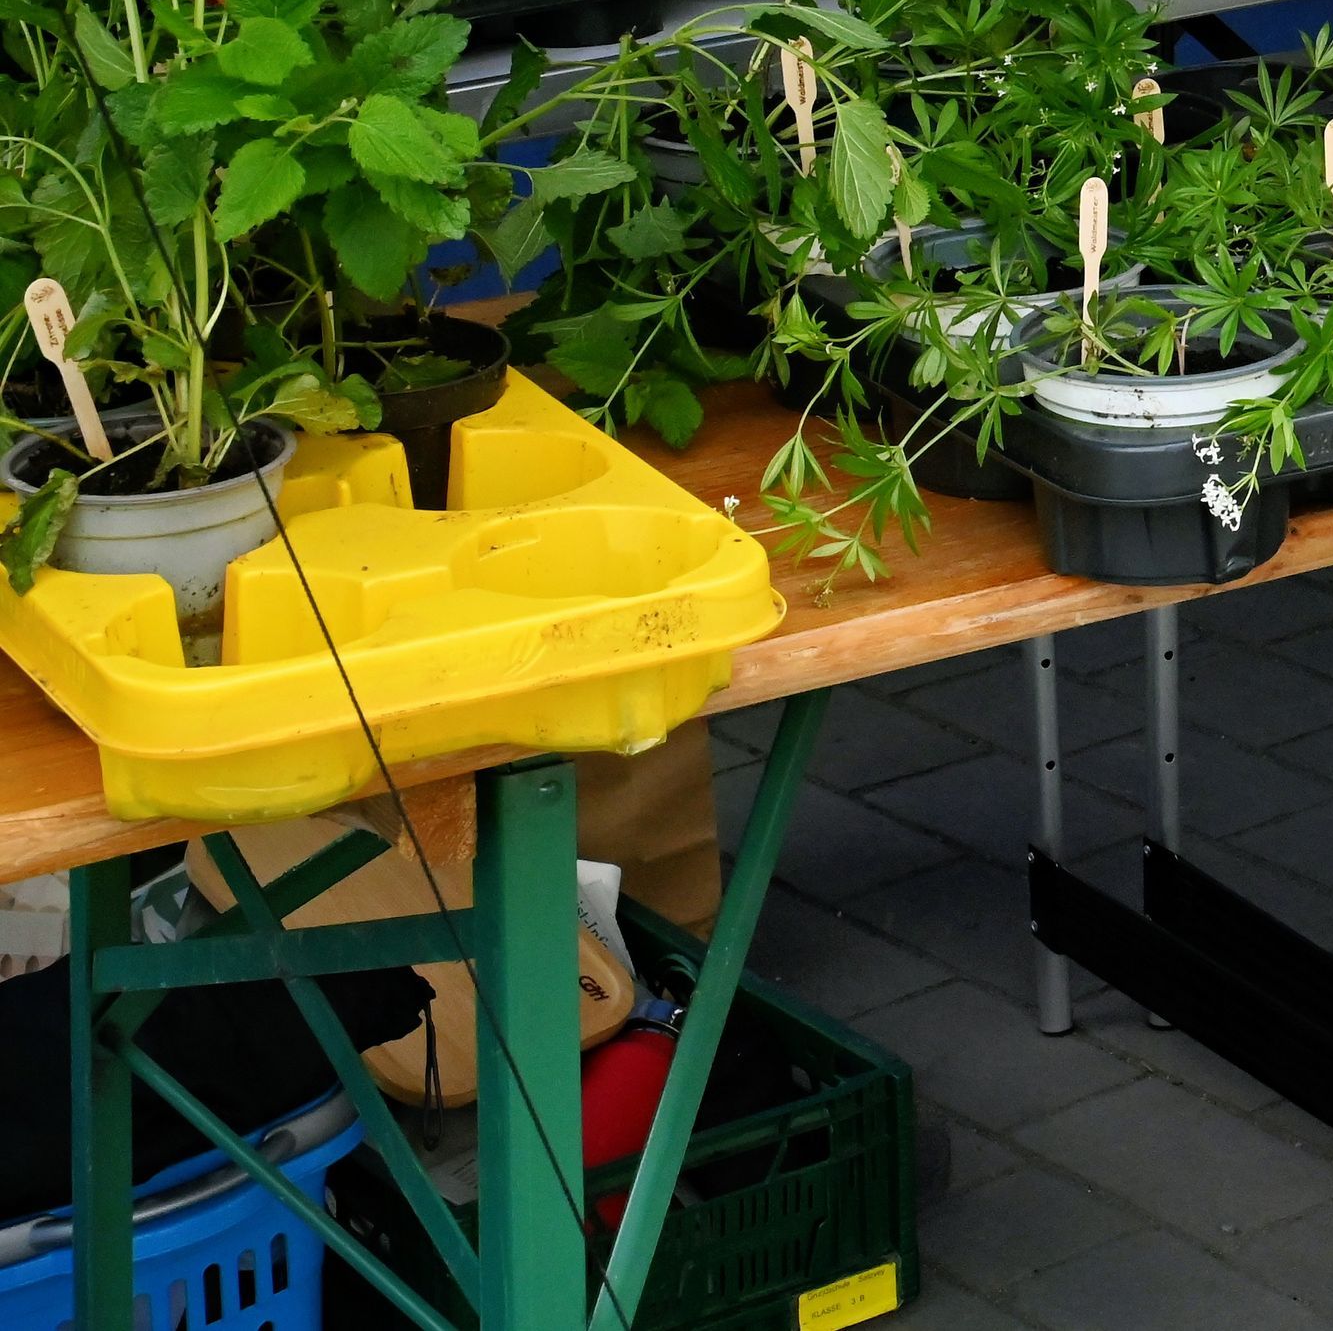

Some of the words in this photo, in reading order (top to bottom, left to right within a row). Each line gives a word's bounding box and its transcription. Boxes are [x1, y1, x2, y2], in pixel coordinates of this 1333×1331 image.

[797, 57, 806, 105] Waldmeist
[1091, 196, 1099, 253] Waldmeister
[811, 1303, 841, 1319] KLASSE
